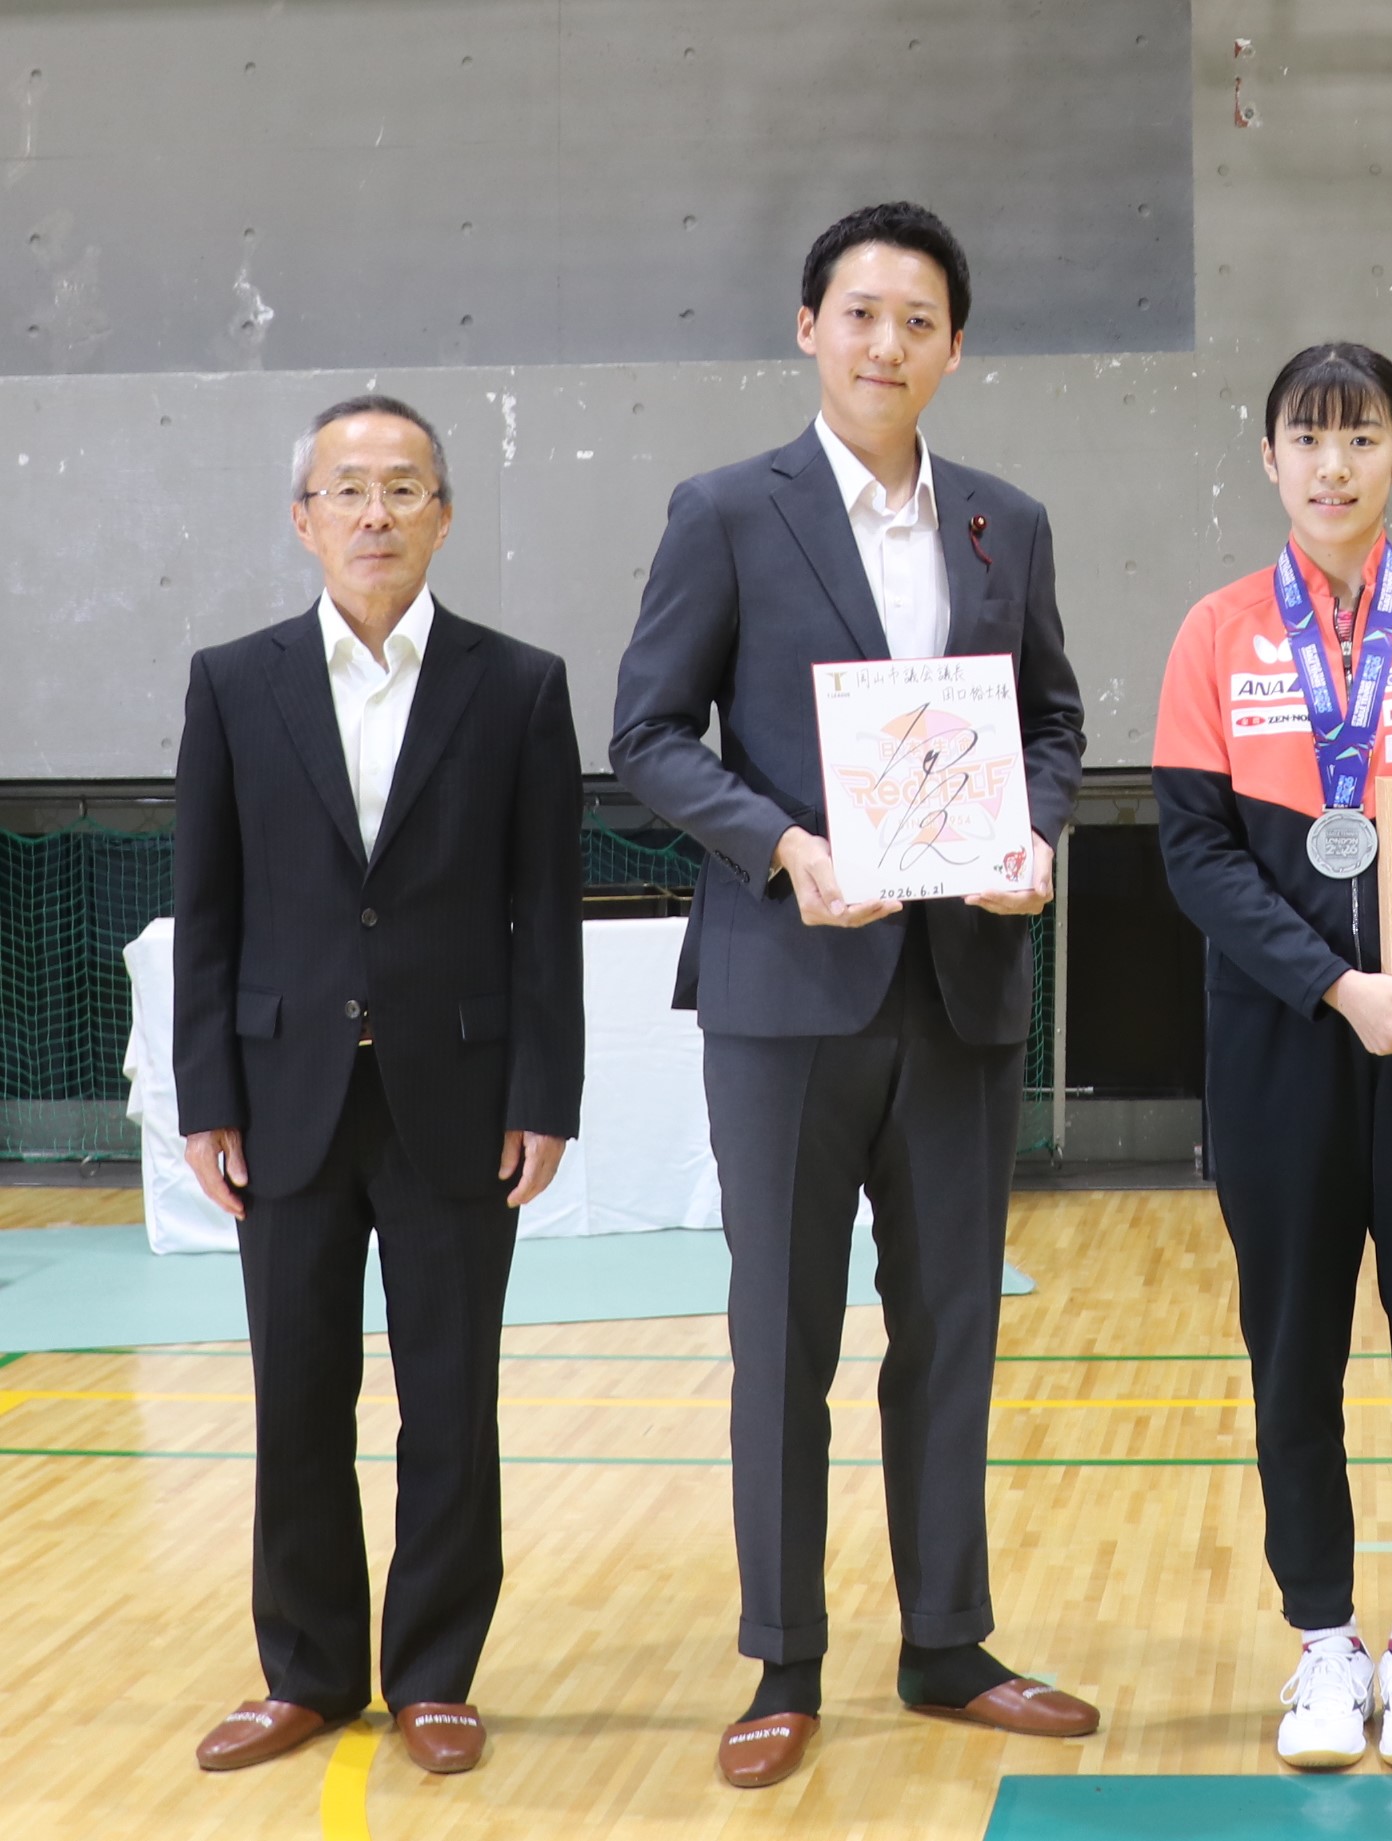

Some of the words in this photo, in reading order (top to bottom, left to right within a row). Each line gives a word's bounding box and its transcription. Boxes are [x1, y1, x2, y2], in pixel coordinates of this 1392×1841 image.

[1238, 679, 1285, 696] ANA
[881, 735, 974, 759] 日本生命
